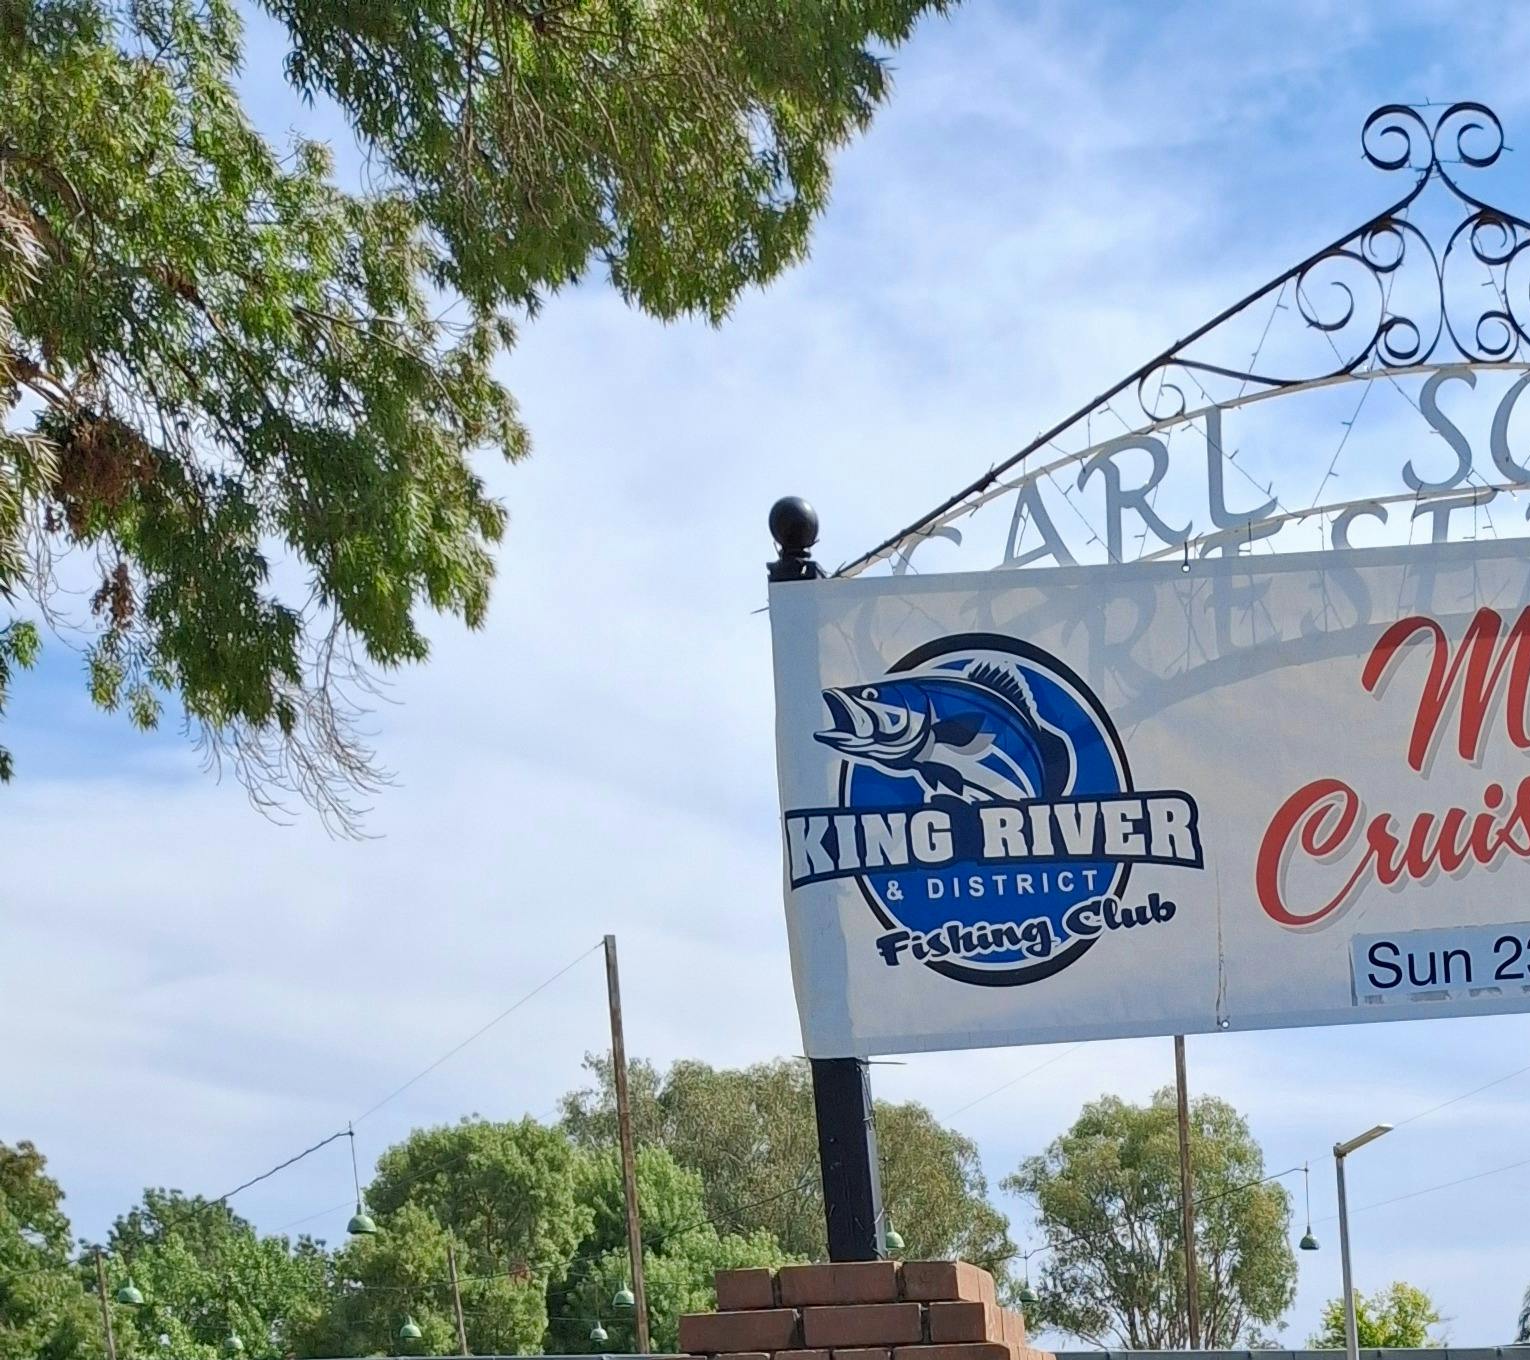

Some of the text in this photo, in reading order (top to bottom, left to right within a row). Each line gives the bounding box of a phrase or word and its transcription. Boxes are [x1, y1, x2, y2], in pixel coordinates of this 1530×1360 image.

[785, 796, 1198, 880] KING RIVER
[886, 869, 1099, 901] & DISTRICT
[875, 892, 1177, 967] Fishing Club
[1366, 941, 1474, 991] Sun
